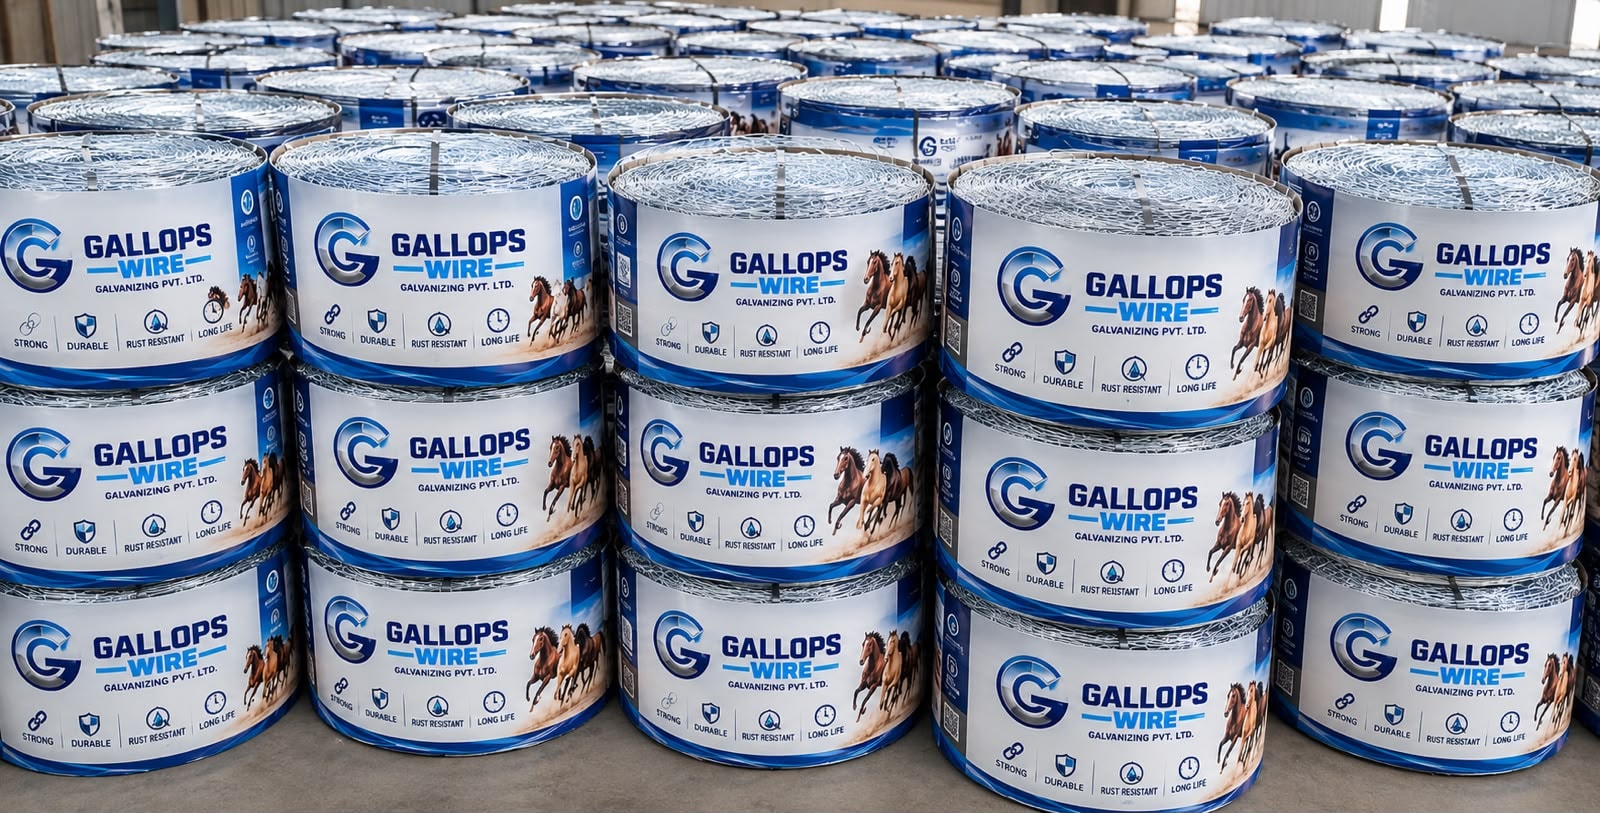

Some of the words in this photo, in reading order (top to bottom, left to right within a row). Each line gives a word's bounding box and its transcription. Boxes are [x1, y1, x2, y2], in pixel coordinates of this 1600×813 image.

[84, 223, 212, 260] GALLOPS
[391, 229, 526, 257] GALLOPS
[1436, 243, 1551, 266] GALLOPS
[116, 252, 184, 279] WIRE
[424, 258, 493, 279] WIRE
[730, 250, 847, 275] GALLOPS
[95, 281, 159, 293] GALVANIZING
[162, 278, 183, 288] PVT.
[186, 274, 205, 284] LTD.
[1464, 268, 1522, 286] WIRE
[400, 283, 464, 292] GALVANIZING
[468, 282, 490, 291] PVT.
[493, 280, 514, 290] LTD.
[758, 276, 819, 294] WIRE
[1086, 272, 1222, 299] GALLOPS
[1440, 288, 1495, 298] GALVANIZING
[1519, 289, 1535, 297] LTD.
[736, 298, 793, 306] GALVANIZING
[796, 298, 815, 306] PVT.
[818, 296, 836, 305] LTD.
[1118, 302, 1189, 322] WIRE
[198, 327, 219, 338] LONG
[220, 322, 233, 333] LIFE
[1092, 324, 1159, 336] GALVANIZING
[1162, 327, 1183, 336] PVT.
[1187, 326, 1206, 335] LTD.
[1351, 325, 1381, 338] STRONG
[14, 338, 48, 349] STRONG
[67, 342, 109, 350] DURABLE
[126, 339, 146, 348] RUST
[360, 335, 396, 347] DURABLE
[411, 340, 429, 348] RUST
[481, 336, 503, 346] LONG
[505, 334, 520, 344] LIFE
[1397, 334, 1432, 345] DURABLE
[1512, 338, 1531, 346] LONG
[1532, 336, 1545, 345] LIFE
[695, 345, 727, 356] DURABLE
[740, 349, 757, 358] RUST
[803, 347, 823, 356] LONG
[824, 345, 838, 354] LIFE
[995, 363, 1026, 379] STRONG
[1043, 375, 1083, 389] DURABLE
[1101, 383, 1121, 393] RUST
[1177, 383, 1199, 393] LONG
[1201, 381, 1216, 391] LIFE
[94, 426, 227, 468] GALLOPS
[410, 428, 530, 459] GALLOPS
[1425, 434, 1537, 460] GALLOPS
[699, 442, 814, 468] GALLOPS
[127, 456, 197, 486] WIRE
[439, 457, 502, 479] WIRE
[1452, 461, 1510, 479] WIRE
[418, 482, 476, 492] GALVANIZING
[479, 480, 499, 489] PVT.
[501, 477, 519, 486] LTD.
[726, 468, 785, 487] WIRE
[105, 485, 170, 500] GALVANIZING
[173, 480, 195, 491] PVT.
[198, 476, 217, 486] LTD.
[1429, 480, 1484, 491] GALVANIZING
[1486, 483, 1504, 491] PVT.
[1507, 483, 1523, 491] LTD.
[706, 487, 759, 499] GALVANIZING
[762, 491, 781, 499] PVT.
[1069, 483, 1198, 510] GALLOPS
[1100, 512, 1166, 531] WIRE
[1340, 514, 1369, 528] STRONG
[196, 526, 216, 539] LONG
[218, 521, 231, 532] LIFE
[491, 530, 512, 540] LONG
[1384, 525, 1418, 538] DURABLE
[1433, 533, 1450, 541] RUST
[375, 532, 408, 543] DURABLE
[680, 533, 711, 546] DURABLE
[788, 540, 808, 549] LONG
[809, 538, 823, 547] LIFE
[1075, 532, 1138, 544] GALVANIZING
[1141, 536, 1162, 544] PVT.
[1164, 534, 1184, 543] LTD.
[1496, 534, 1515, 543] LONG
[1516, 533, 1528, 541] LIFE
[15, 543, 48, 554] STRONG
[66, 546, 107, 555] DURABLE
[124, 542, 144, 552] RUST
[981, 560, 1010, 576] STRONG
[1026, 574, 1064, 589] DURABLE
[1081, 585, 1100, 594] RUST
[1154, 586, 1176, 595] LONG
[1178, 583, 1193, 593] LIFE
[93, 615, 228, 661] GALLOPS
[386, 620, 508, 646] GALLOPS
[722, 633, 841, 659] GALLOPS
[1411, 639, 1529, 666] GALLOPS
[126, 647, 197, 679] WIRE
[414, 647, 478, 666] WIRE
[394, 666, 452, 677] GALVANIZING
[454, 669, 475, 677] PVT.
[478, 667, 497, 675] LTD.
[750, 661, 812, 679] WIRE
[1440, 667, 1500, 685] WIRE
[104, 677, 169, 692] GALVANIZING
[172, 672, 195, 683] PVT.
[197, 665, 218, 677] LTD.
[728, 681, 785, 691] GALVANIZING
[788, 683, 808, 691] PVT.
[810, 680, 828, 689] LTD.
[1082, 682, 1208, 709] GALLOPS
[1415, 684, 1473, 697] GALVANIZING
[1476, 689, 1495, 697] PVT.
[1498, 688, 1515, 696] LTD.
[199, 717, 220, 730] LONG
[221, 710, 235, 722] LIFE
[365, 709, 397, 723] DURABLE
[411, 718, 428, 727] RUST
[477, 716, 499, 726] LONG
[500, 713, 515, 722] LIFE
[1113, 710, 1177, 729] WIRE
[1327, 709, 1357, 726] STRONG
[694, 723, 727, 737] DURABLE
[742, 732, 759, 741] RUST
[808, 729, 829, 739] LONG
[830, 726, 844, 736] LIFE
[1152, 733, 1172, 741] PVT.
[1176, 731, 1194, 740] LTD.
[22, 732, 54, 745] STRONG
[71, 739, 111, 747] DURABLE
[128, 735, 147, 745] RUST
[1426, 735, 1445, 744] RUST
[1493, 736, 1512, 744] LONG
[1513, 733, 1525, 742] LIFE
[995, 759, 1027, 777] STRONG
[1044, 776, 1084, 791] DURABLE
[1100, 786, 1120, 795] RUST
[1171, 783, 1191, 793] LONG
[1193, 778, 1206, 789] LIFE
